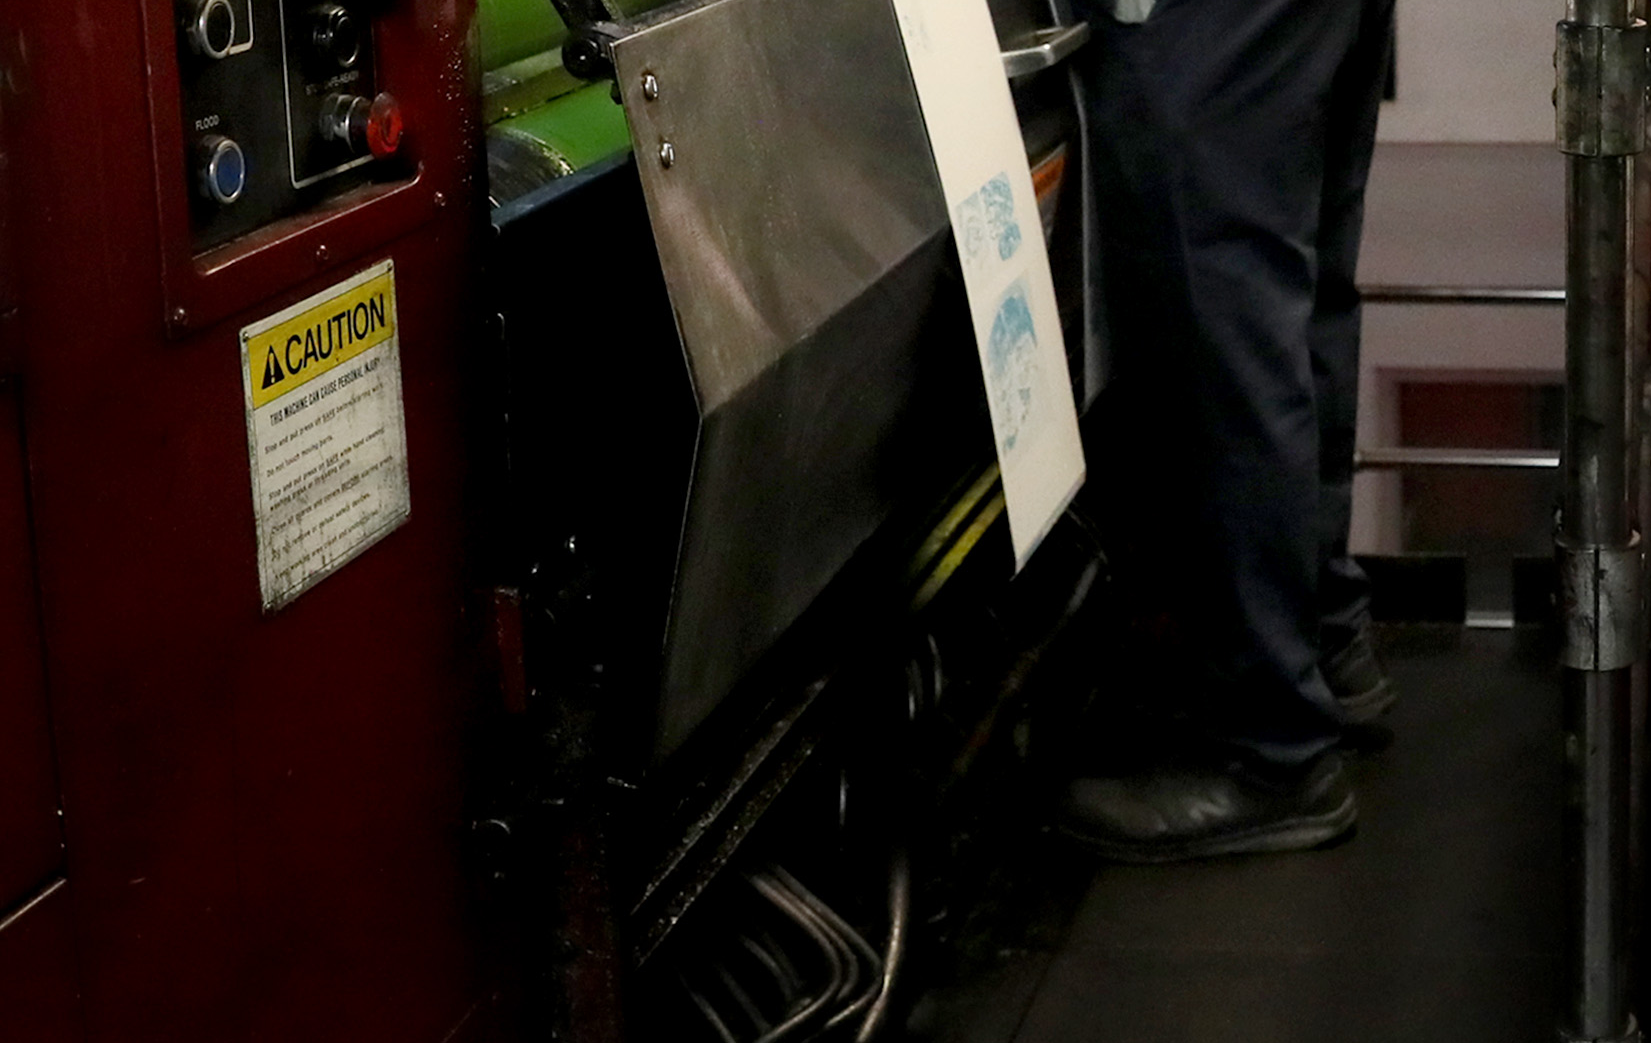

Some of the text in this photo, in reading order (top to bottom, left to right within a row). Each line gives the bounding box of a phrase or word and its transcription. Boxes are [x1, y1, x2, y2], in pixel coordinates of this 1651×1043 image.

[195, 114, 220, 132] FLOOD
[284, 294, 385, 374] CAUTION
[270, 410, 282, 426] THIS
